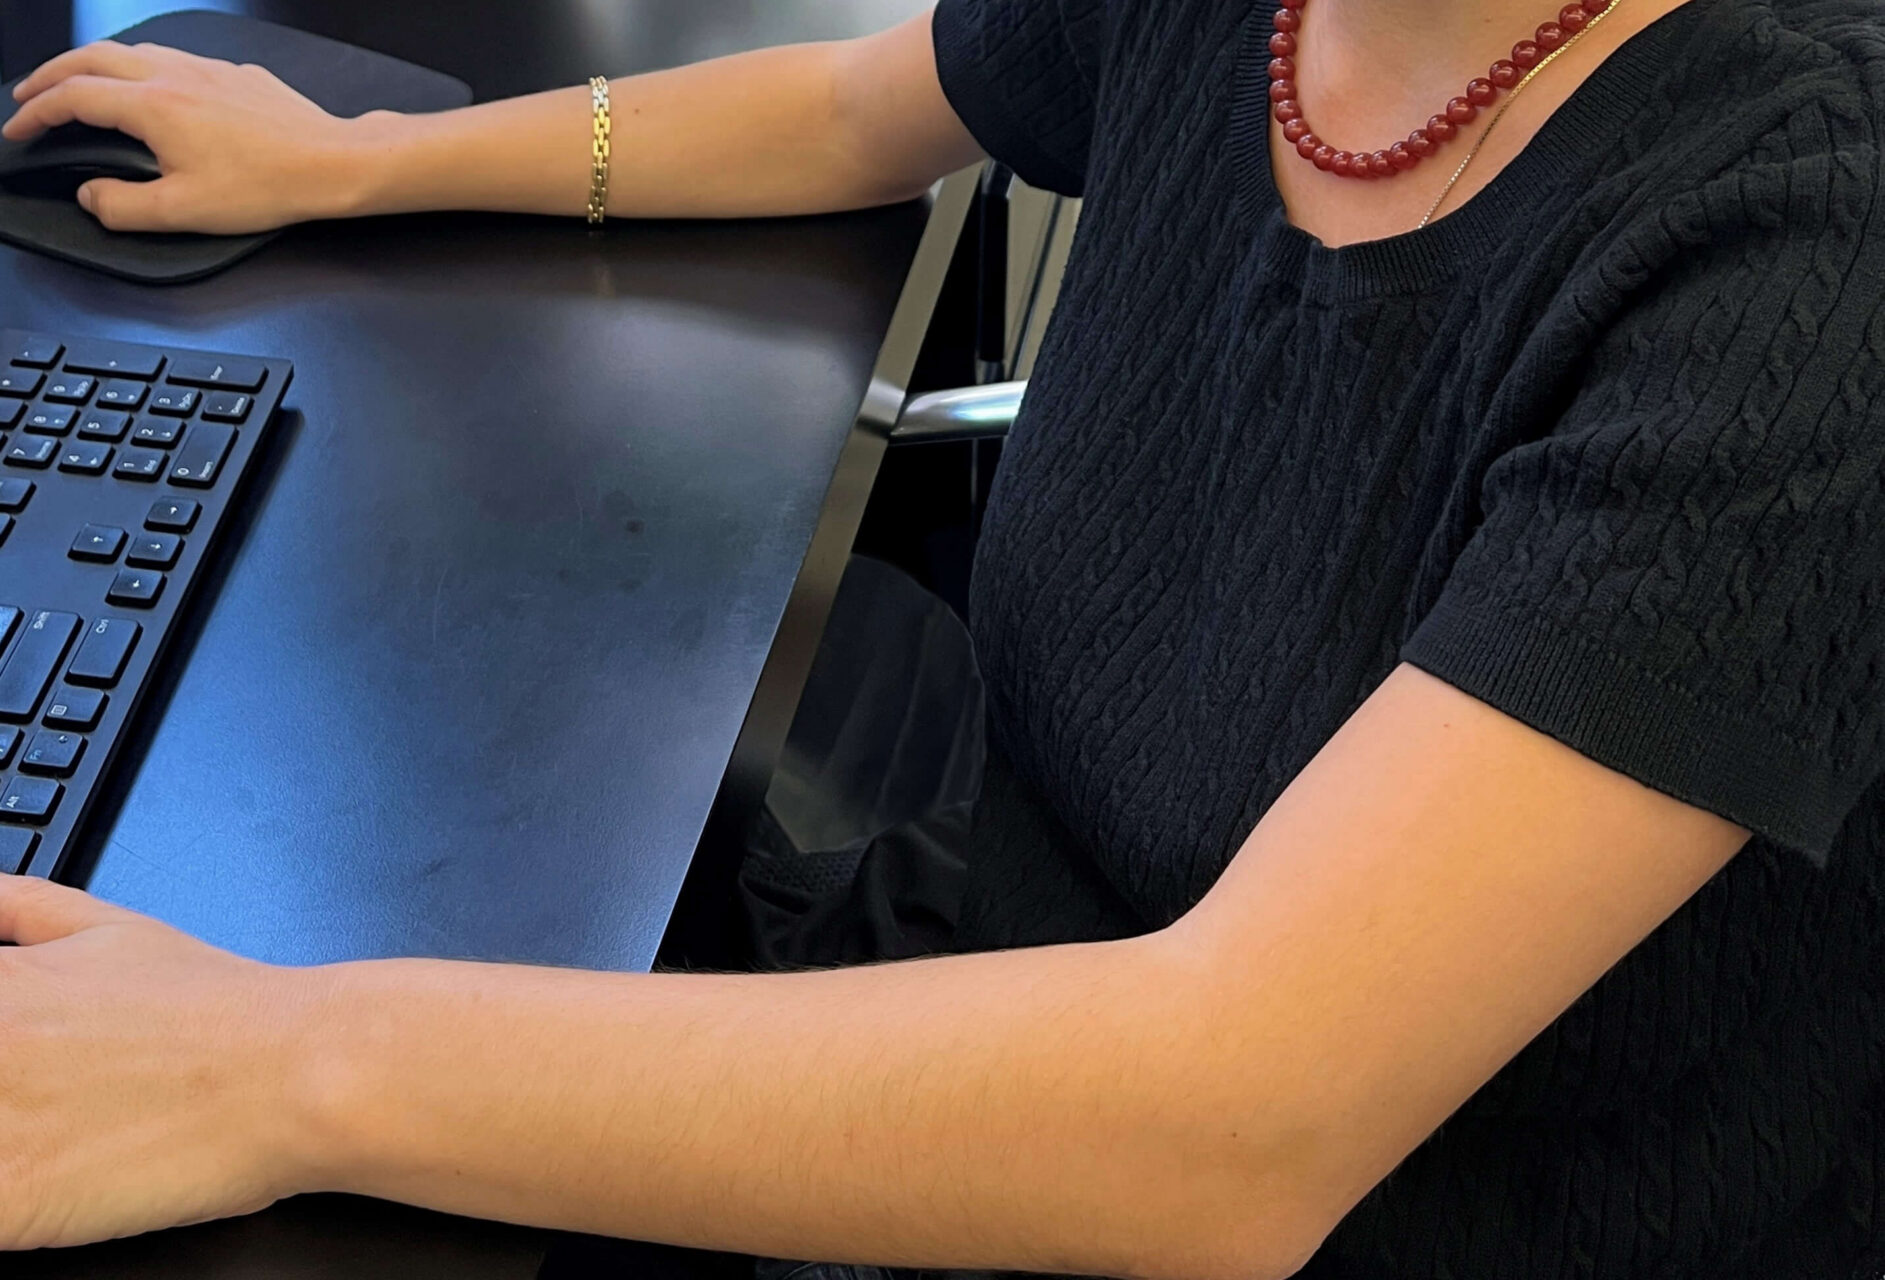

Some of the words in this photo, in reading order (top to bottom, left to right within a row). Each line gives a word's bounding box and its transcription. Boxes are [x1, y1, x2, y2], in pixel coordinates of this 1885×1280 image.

[34, 612, 50, 629] Shift
[96, 620, 108, 633] Ctrl
[29, 748, 42, 760] Fn
[7, 796, 19, 807] Alt
